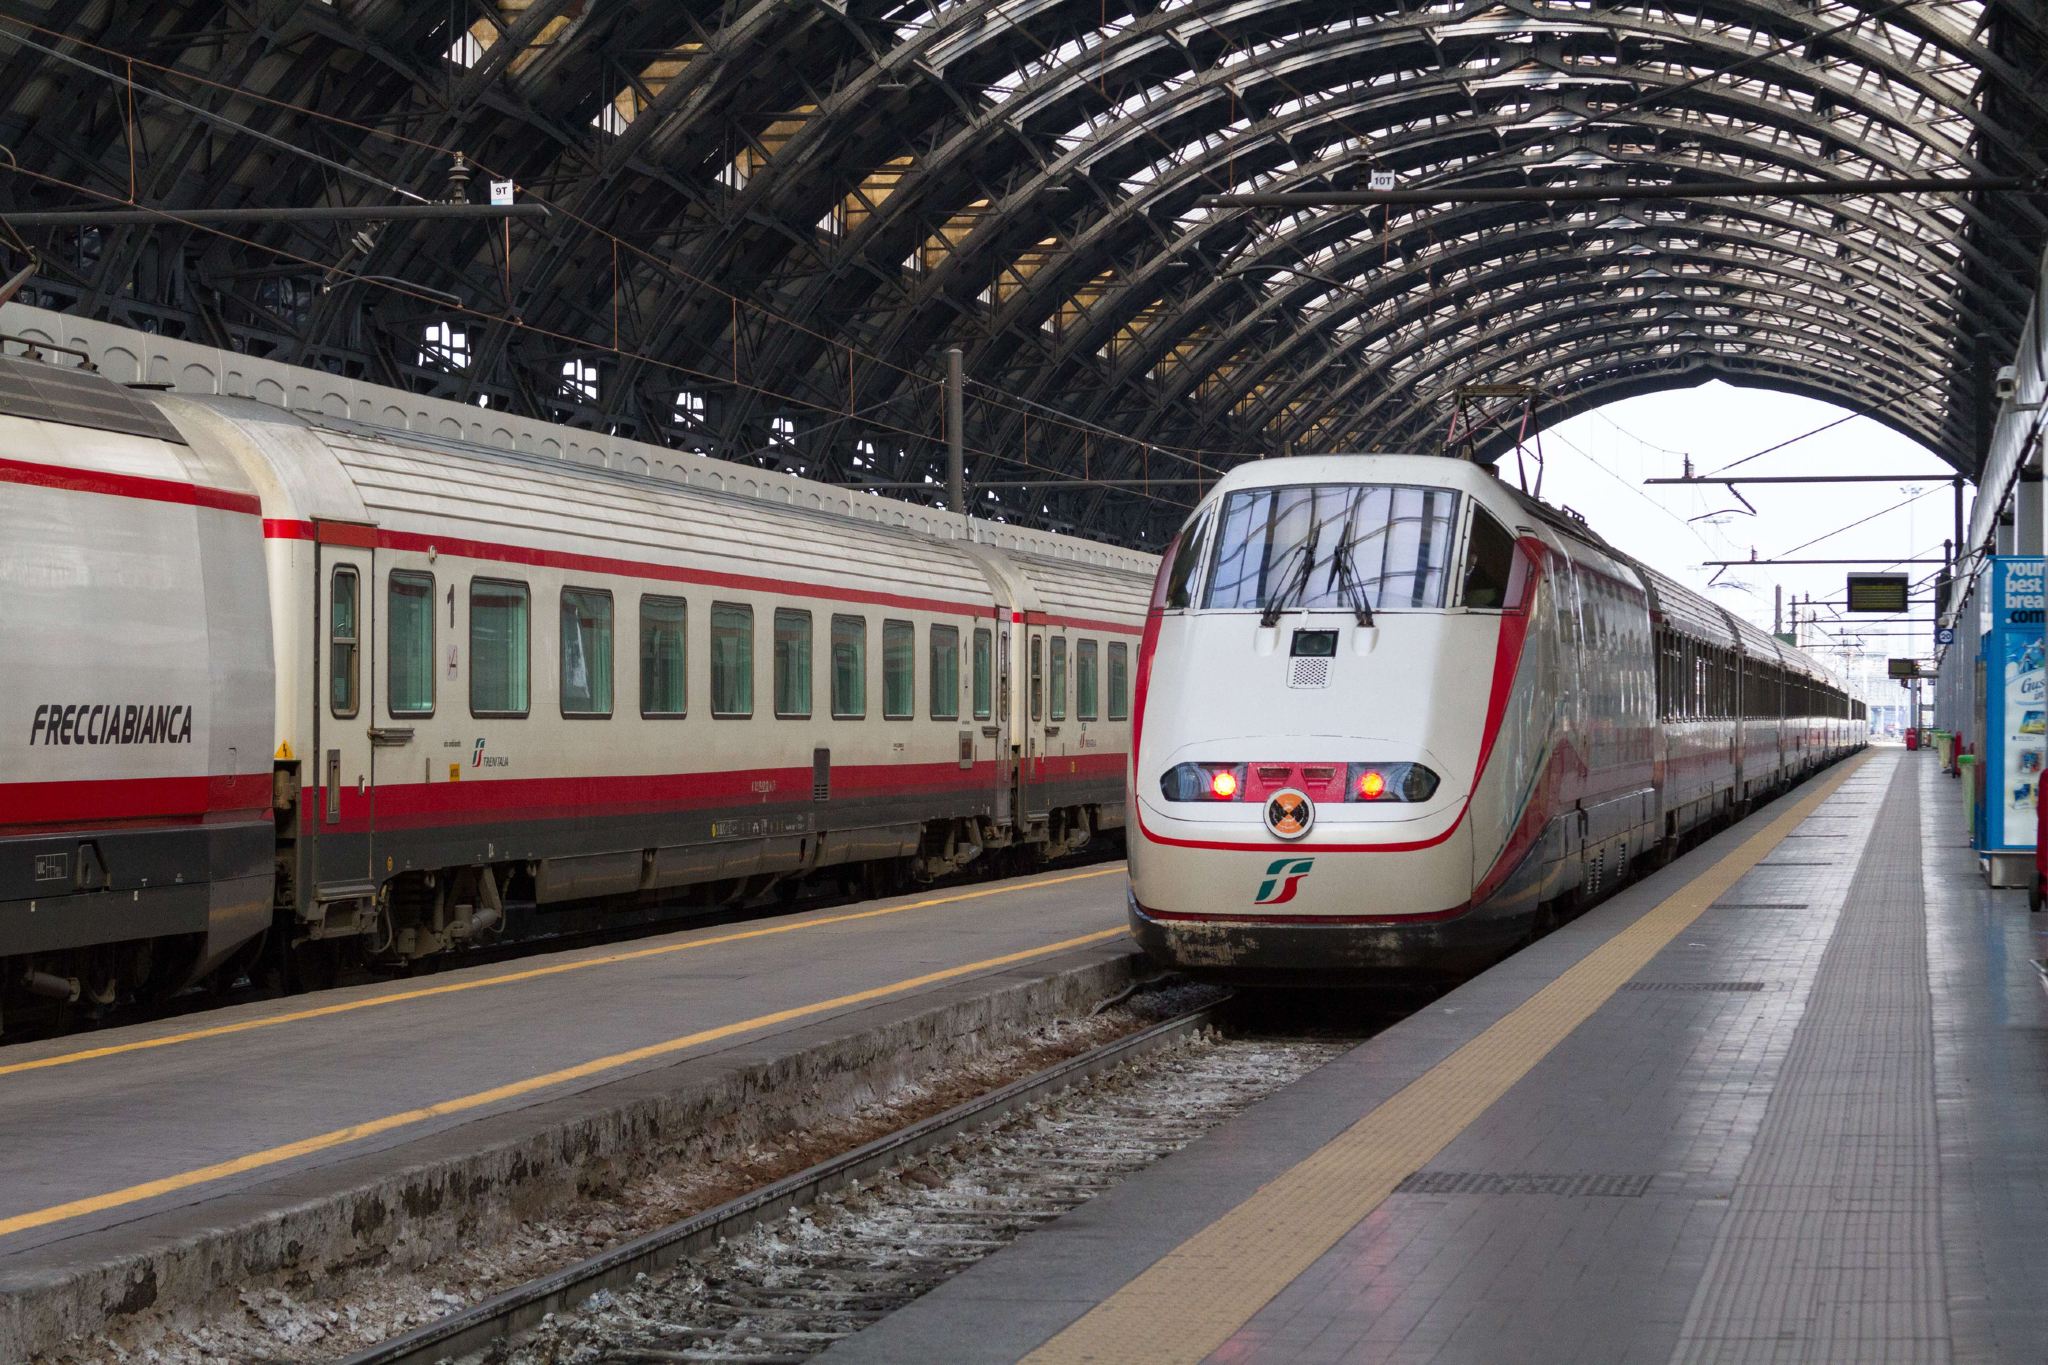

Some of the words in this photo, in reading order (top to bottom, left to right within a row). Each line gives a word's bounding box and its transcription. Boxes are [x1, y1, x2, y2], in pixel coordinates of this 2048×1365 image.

[1374, 176, 1392, 185] 10T
[495, 187, 507, 195] 9T
[2006, 562, 2046, 577] your
[2005, 577, 2042, 593] best
[447, 584, 454, 628] 1
[2005, 610, 2046, 624] .com
[29, 704, 192, 745] FRECCIABIANCA
